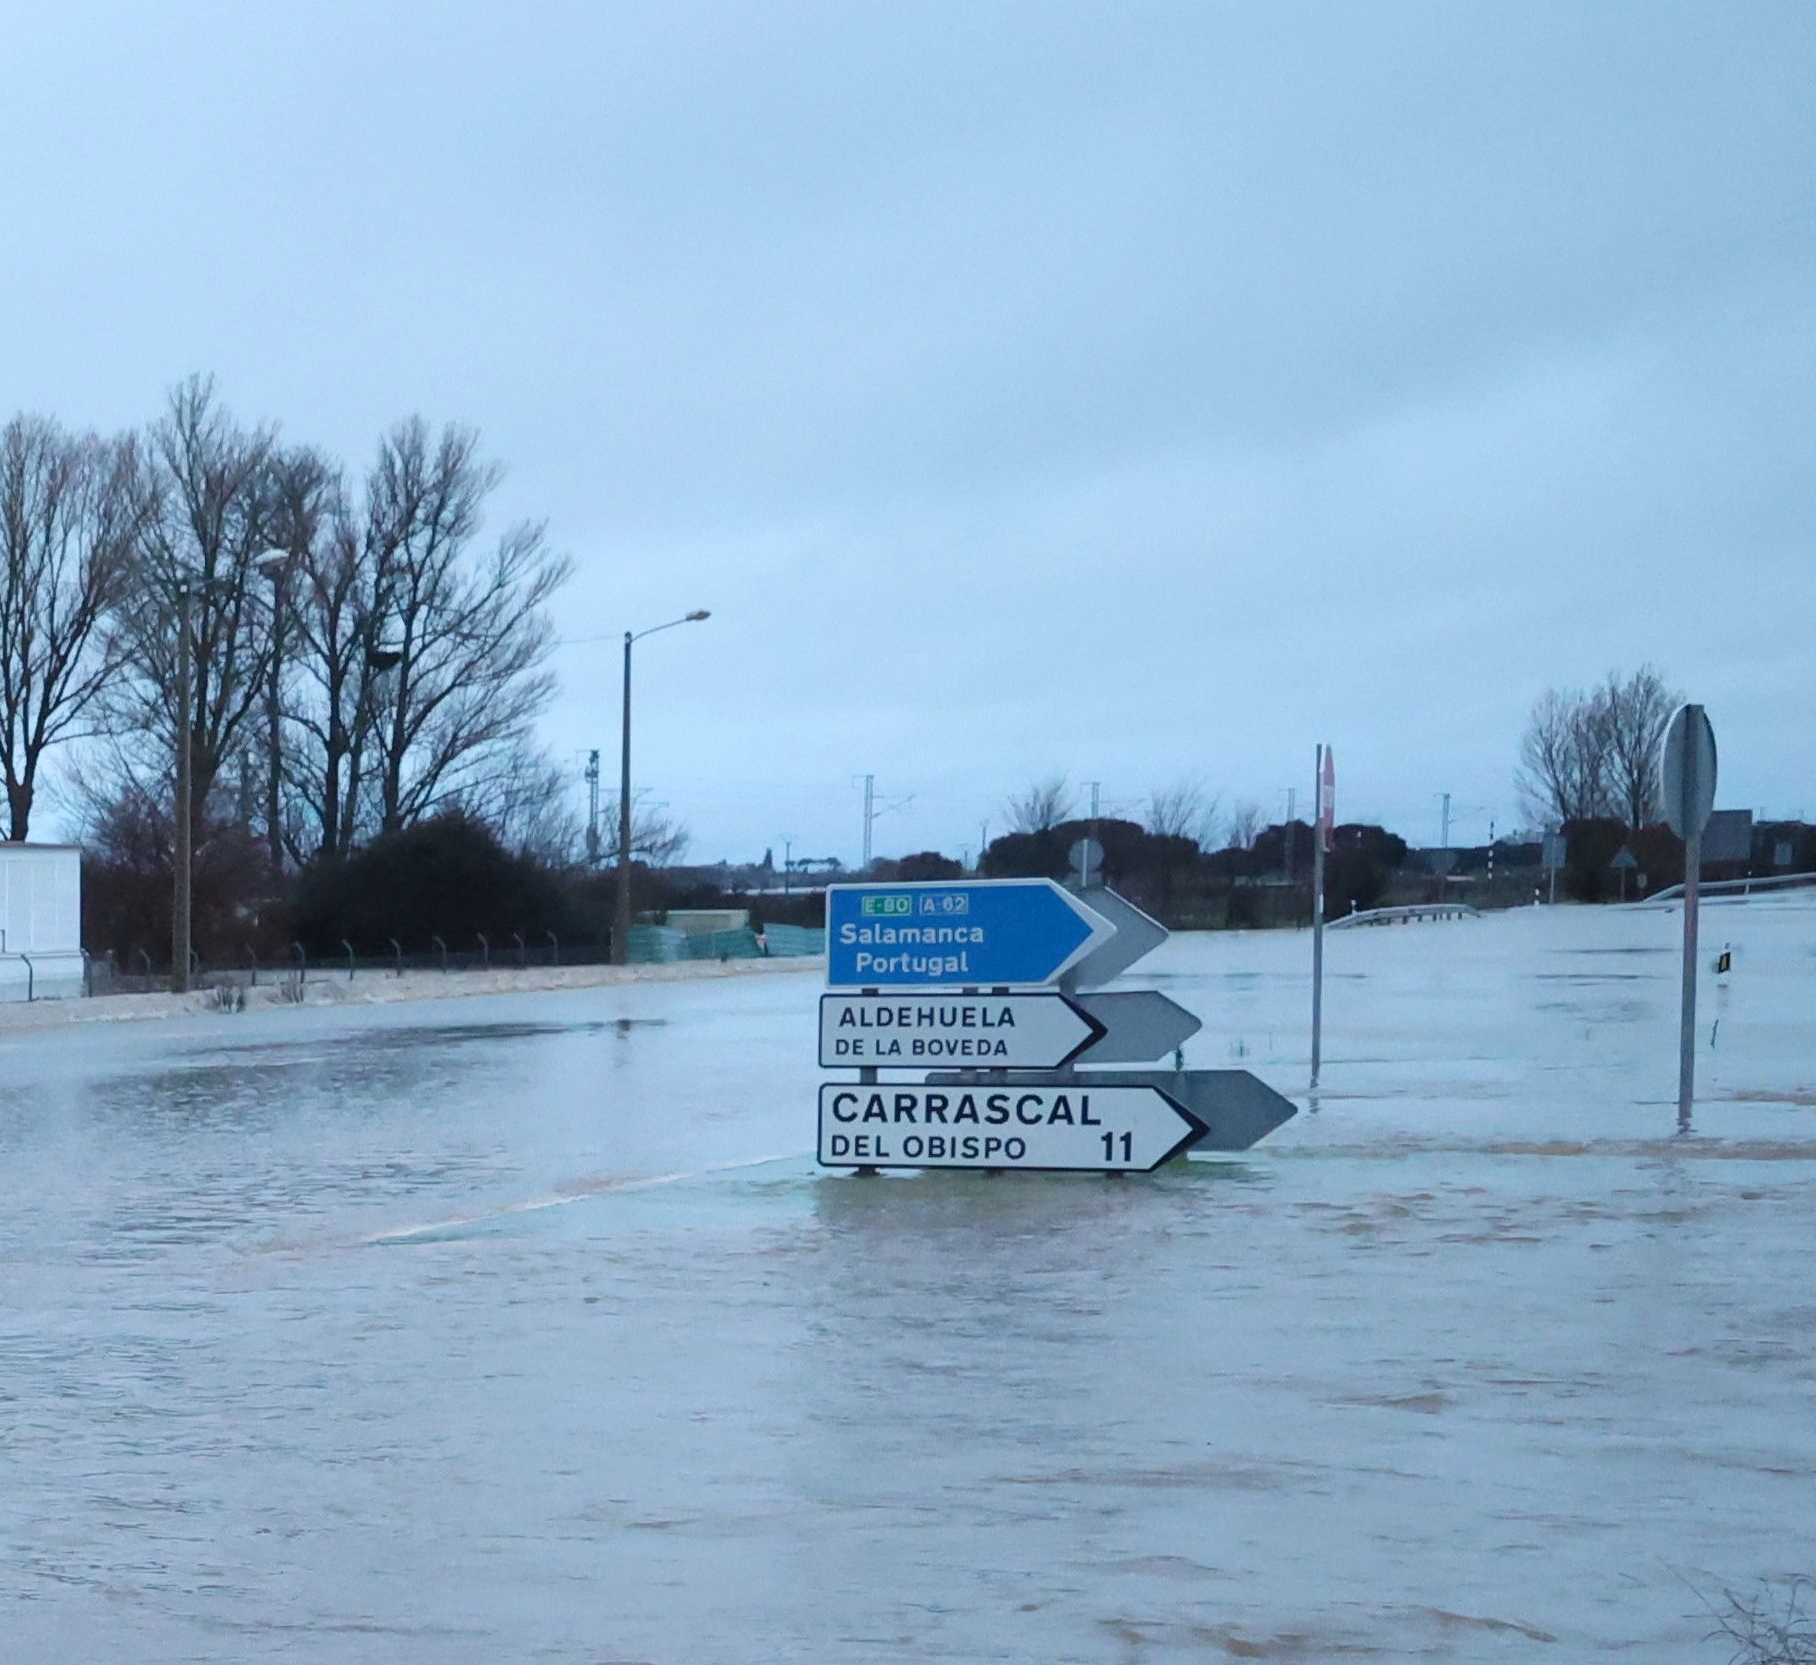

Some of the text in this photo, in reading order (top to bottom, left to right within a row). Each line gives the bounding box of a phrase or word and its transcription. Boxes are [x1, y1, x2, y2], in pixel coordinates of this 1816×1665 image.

[866, 896, 967, 913] E-80 A-62
[839, 922, 984, 945] Salamanca
[856, 951, 969, 977] Portugal
[838, 1006, 1015, 1028] ALDEHUELA
[835, 1038, 1008, 1056] DE LA BOVEDA
[831, 1092, 1102, 1127] CARRASCAL
[831, 1131, 1133, 1163] DEL OBISPO 11
